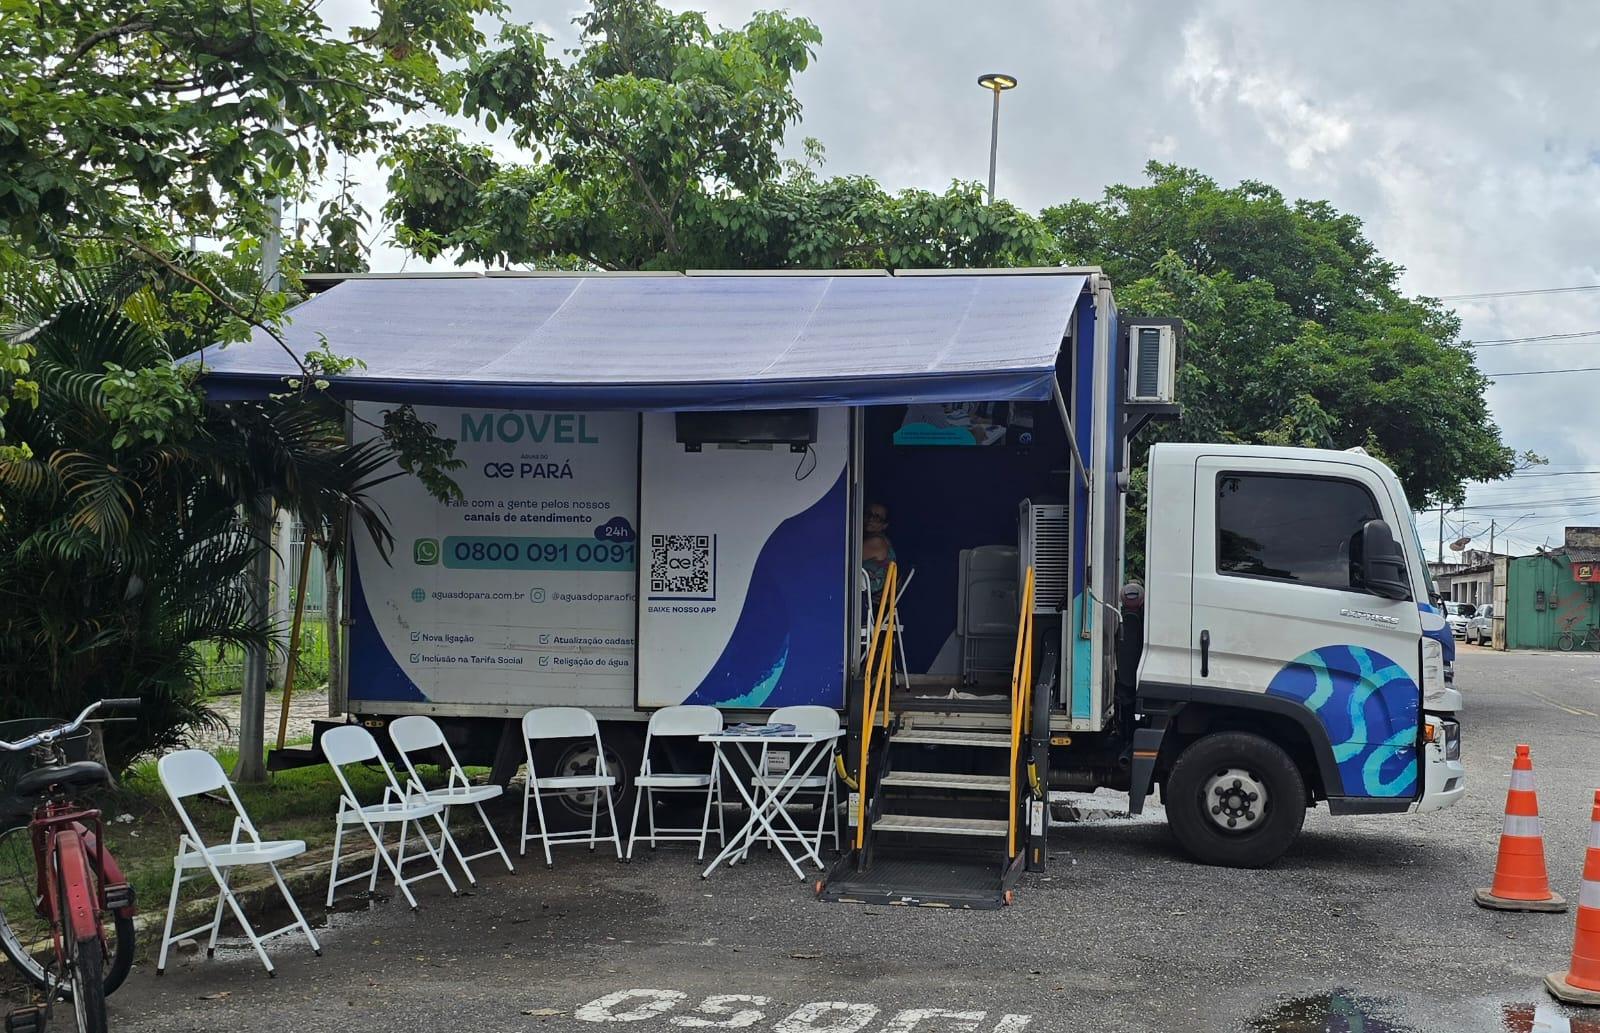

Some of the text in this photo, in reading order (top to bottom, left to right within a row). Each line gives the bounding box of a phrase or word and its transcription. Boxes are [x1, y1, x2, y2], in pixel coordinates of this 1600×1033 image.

[520, 459, 573, 479] PARÁ
[471, 500, 495, 508] com
[497, 500, 504, 508] a
[507, 500, 538, 511] gente
[541, 499, 569, 510] pelos
[572, 500, 610, 510] nossos
[464, 513, 592, 523] canais de atendimento
[605, 526, 628, 537] 24h
[455, 542, 635, 563] 0800 091 0091
[431, 590, 525, 600] aguasdopara.com.br
[1339, 608, 1400, 625] EXPRESS
[422, 633, 474, 644] Nova ligação
[553, 636, 603, 646] Atualização
[421, 655, 456, 664] Inclusão
[471, 656, 495, 664] Tarifa
[497, 656, 523, 665] Social
[553, 657, 594, 667] Religação
[608, 657, 629, 668] água
